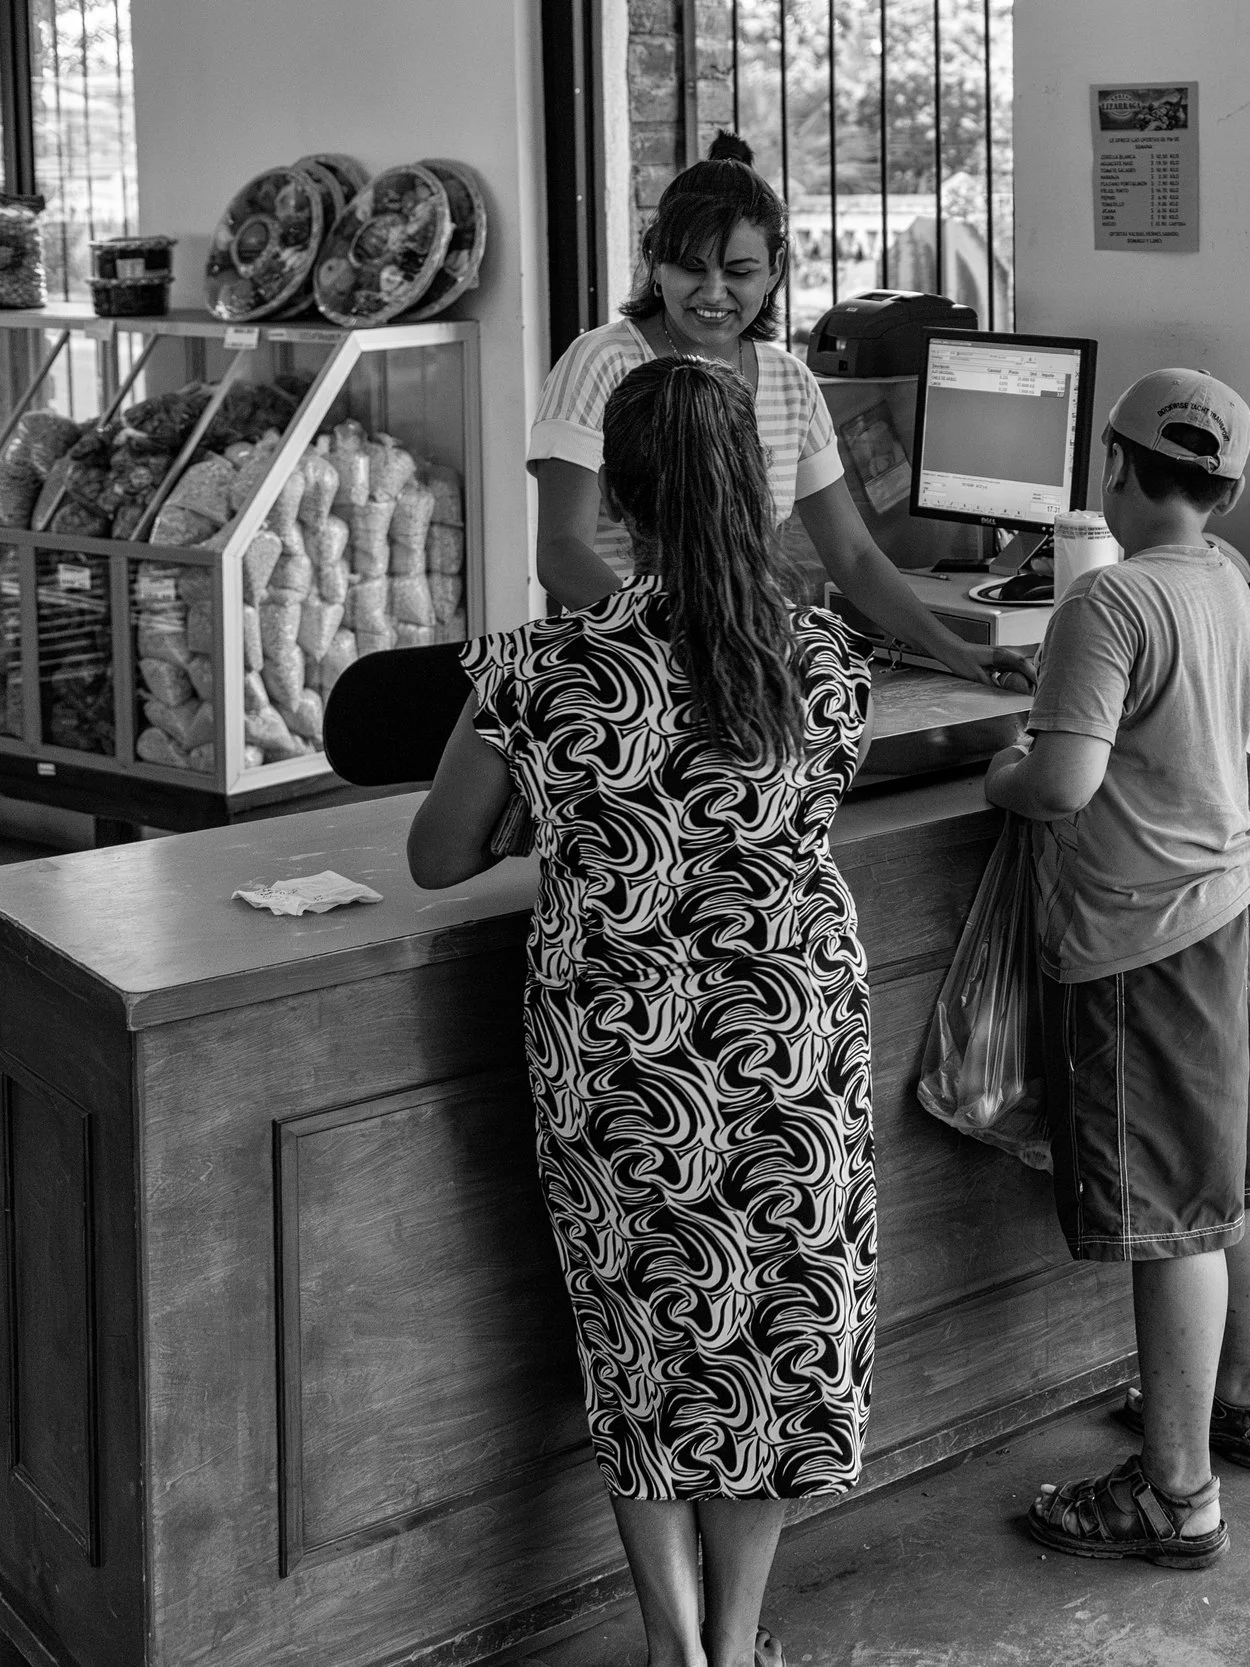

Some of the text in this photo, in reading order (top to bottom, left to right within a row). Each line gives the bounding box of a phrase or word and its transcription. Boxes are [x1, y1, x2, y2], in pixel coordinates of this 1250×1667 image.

[1101, 102, 1142, 110] LIZARRAGA
[1157, 402, 1230, 442] DOCKWISE YACHT TRANSPORT
